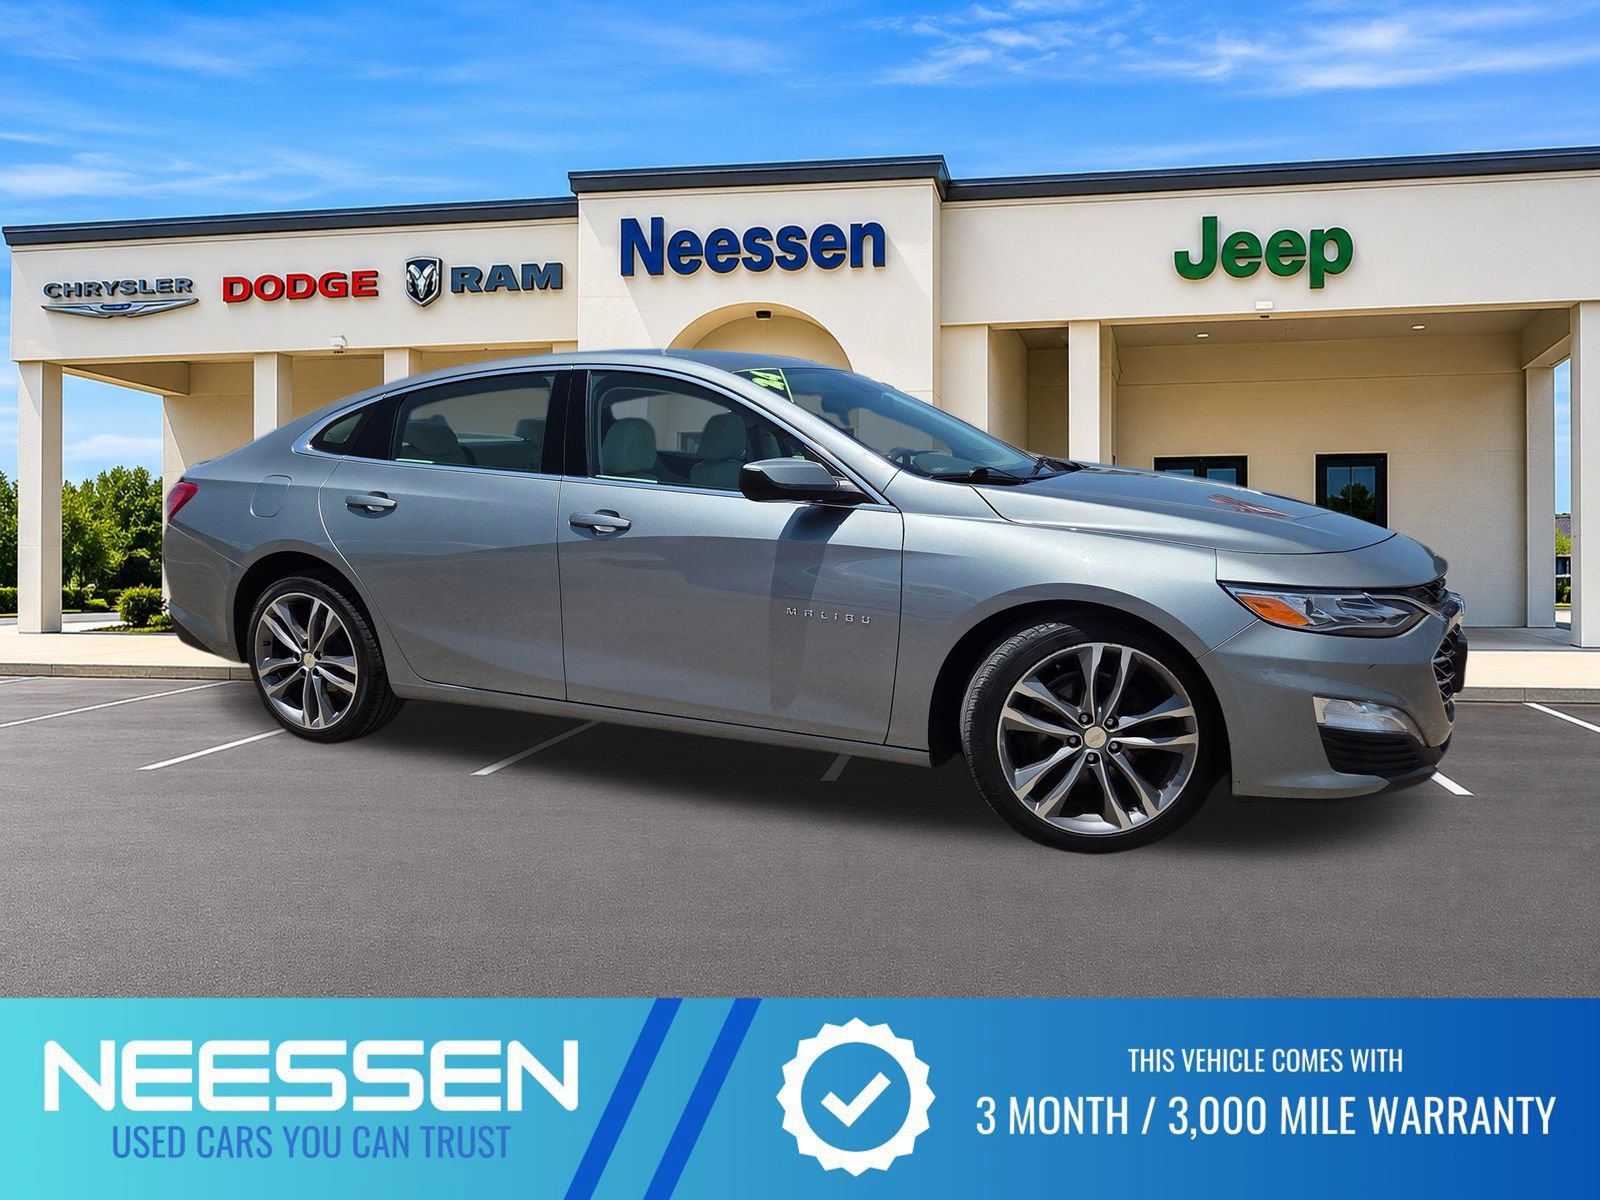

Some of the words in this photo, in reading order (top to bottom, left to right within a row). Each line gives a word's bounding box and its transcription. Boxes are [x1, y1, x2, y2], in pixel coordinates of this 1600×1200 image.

[620, 216, 886, 277] Neessen
[1174, 215, 1354, 289] Jeep
[43, 277, 194, 299] CHRYSLER
[222, 270, 379, 303] DODGE
[450, 262, 563, 293] RAM
[786, 607, 870, 624] MALIBU
